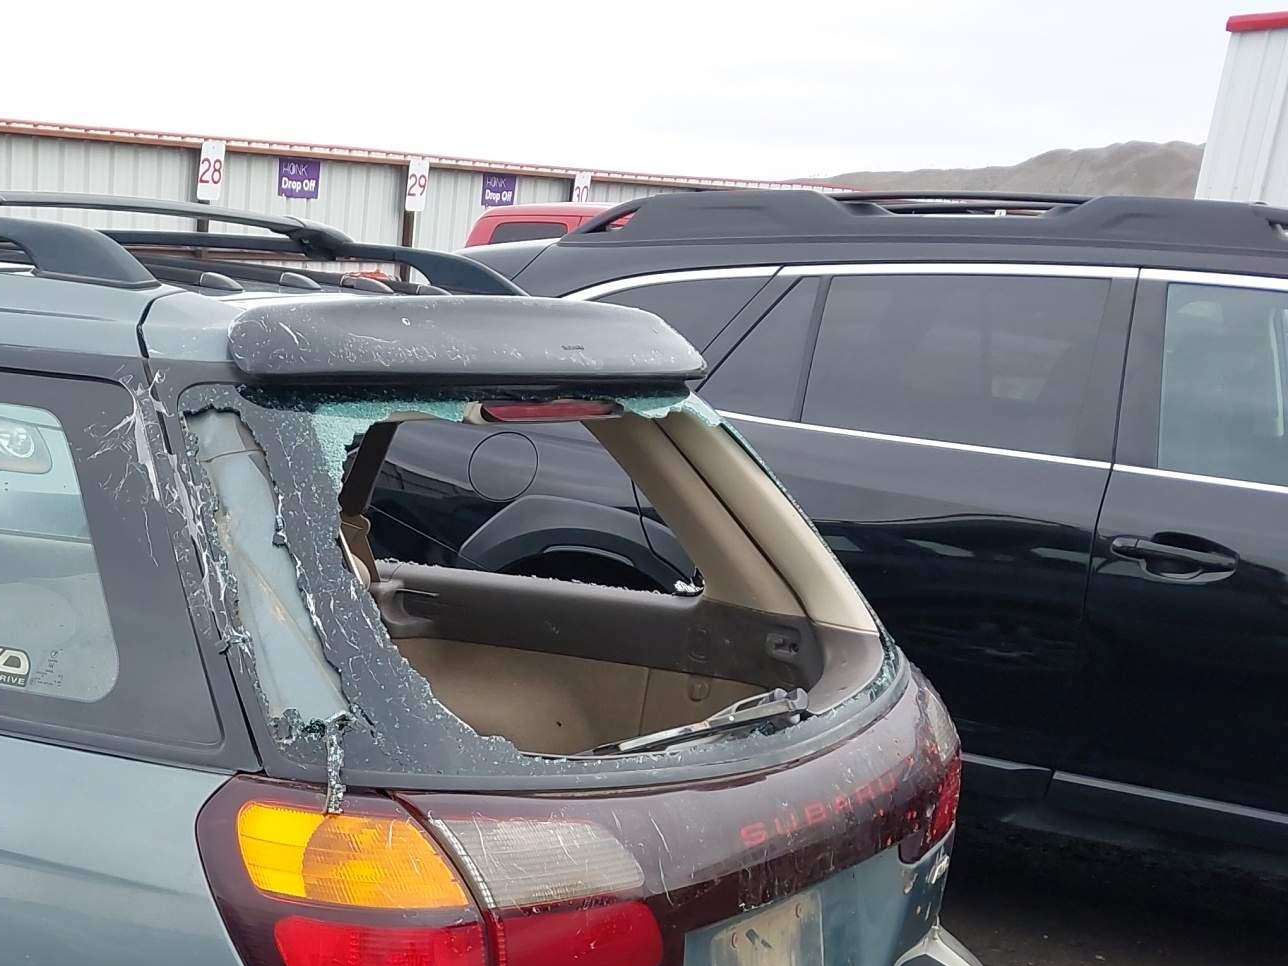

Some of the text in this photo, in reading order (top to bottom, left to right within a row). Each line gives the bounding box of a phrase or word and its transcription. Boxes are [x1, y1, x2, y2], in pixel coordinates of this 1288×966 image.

[199, 158, 222, 185] 28
[282, 176, 316, 192] Drop Off
[407, 173, 427, 197] 29
[485, 188, 512, 203] Drop Off
[740, 770, 898, 849] SUBARU
